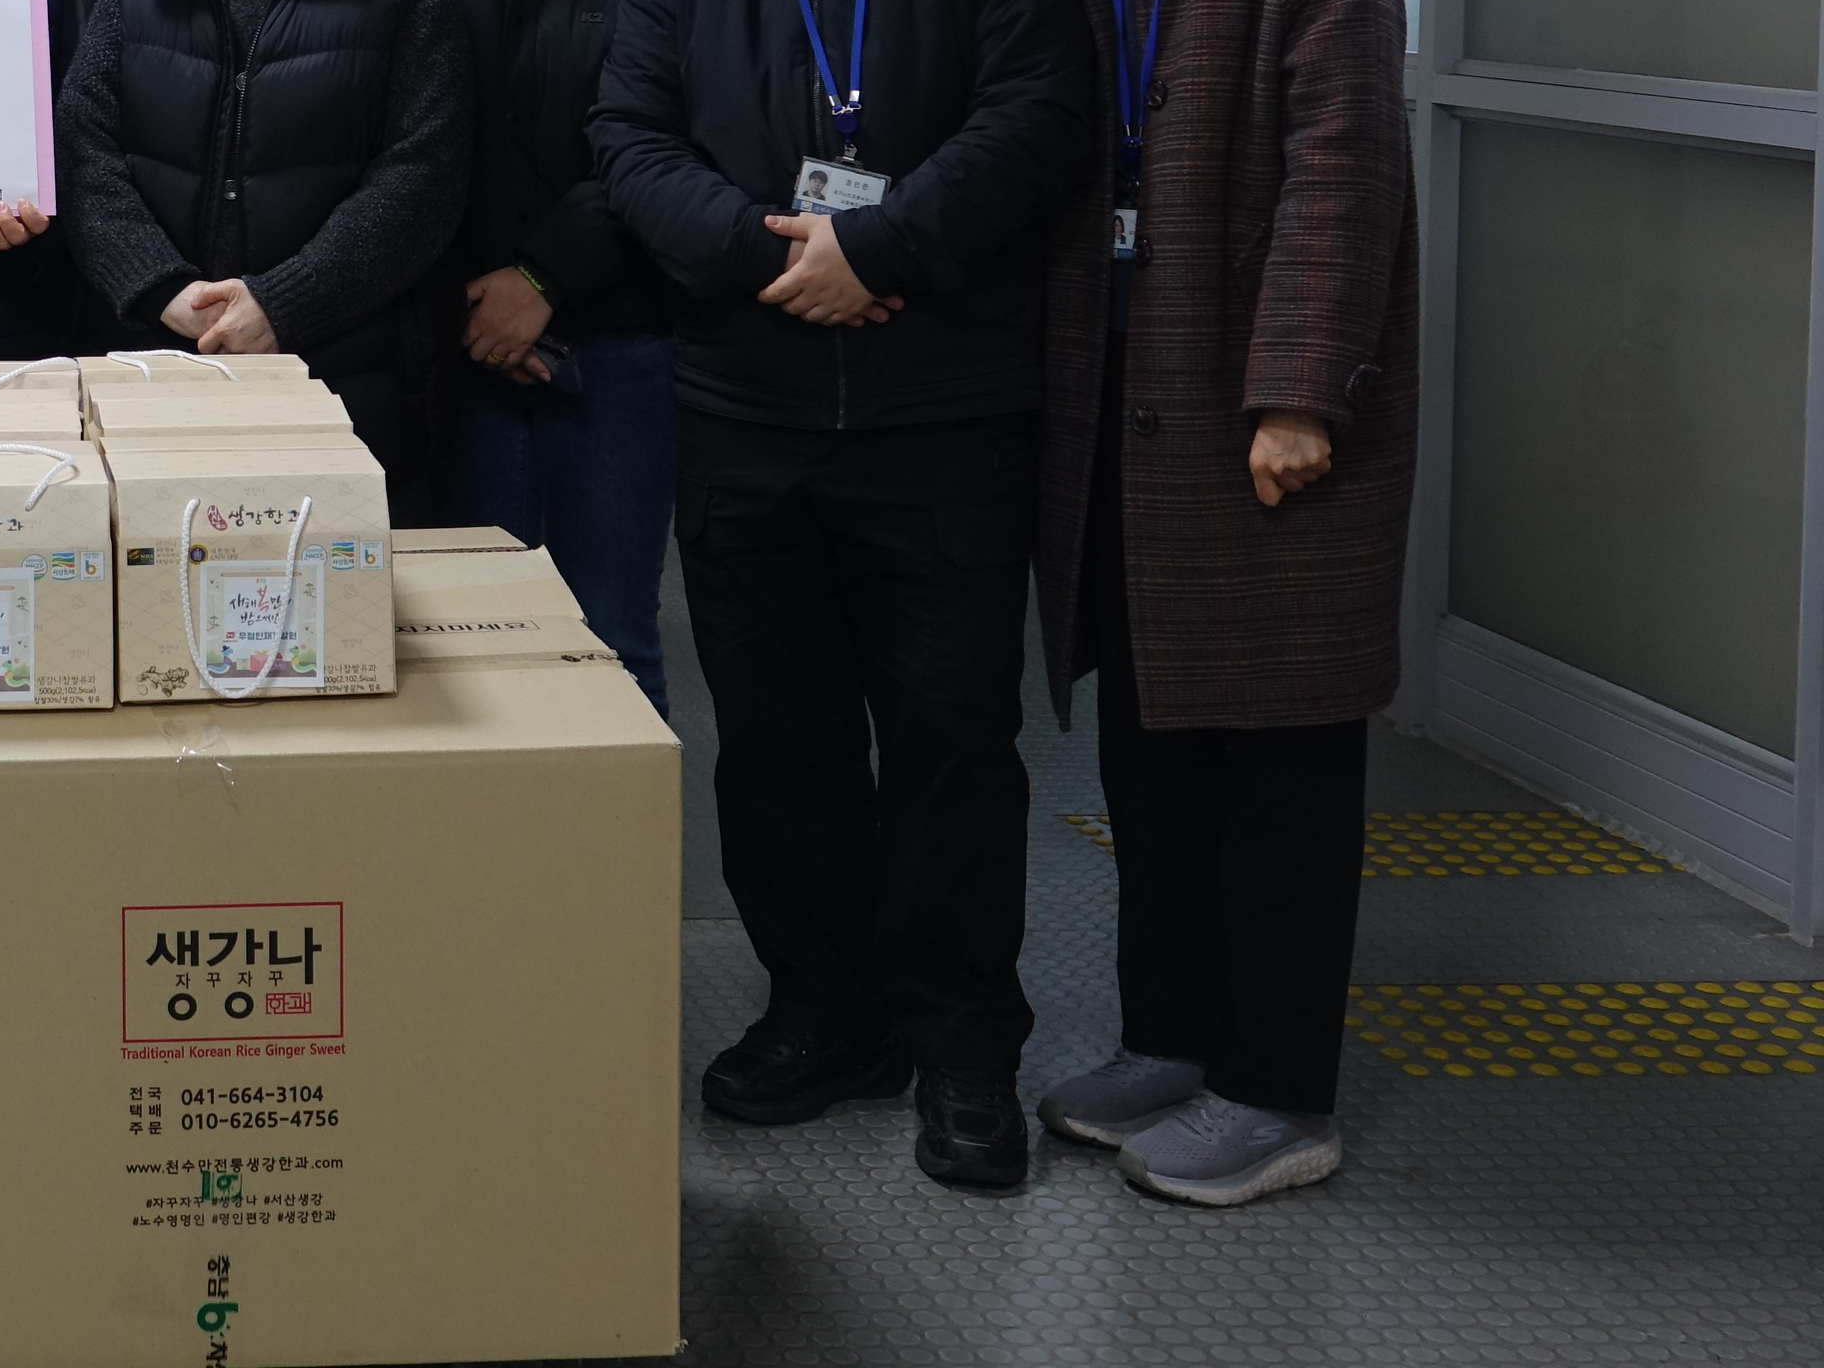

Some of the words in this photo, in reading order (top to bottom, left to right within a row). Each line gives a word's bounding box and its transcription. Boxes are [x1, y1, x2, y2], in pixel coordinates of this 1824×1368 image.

[324, 663, 377, 674] 강나찹쌀유과
[145, 926, 323, 1021] 생강나
[120, 1045, 185, 1061] Traditional
[189, 1045, 232, 1059] Korean
[236, 1044, 261, 1058] Rice
[265, 1043, 306, 1060] Ginger
[309, 1042, 347, 1056] Sweet
[181, 1085, 324, 1106] 041-664-3104
[181, 1109, 340, 1131] 010-6265-4756
[125, 1155, 344, 1175] www.천수만전통생강한과.com
[146, 1195, 205, 1209] #자꾸자꾸
[210, 1194, 258, 1209] #생강나
[263, 1193, 323, 1207] #서산생강
[132, 1213, 205, 1227] #노수영명인
[211, 1212, 272, 1225] #명인편강
[277, 1210, 337, 1223] #생강한과
